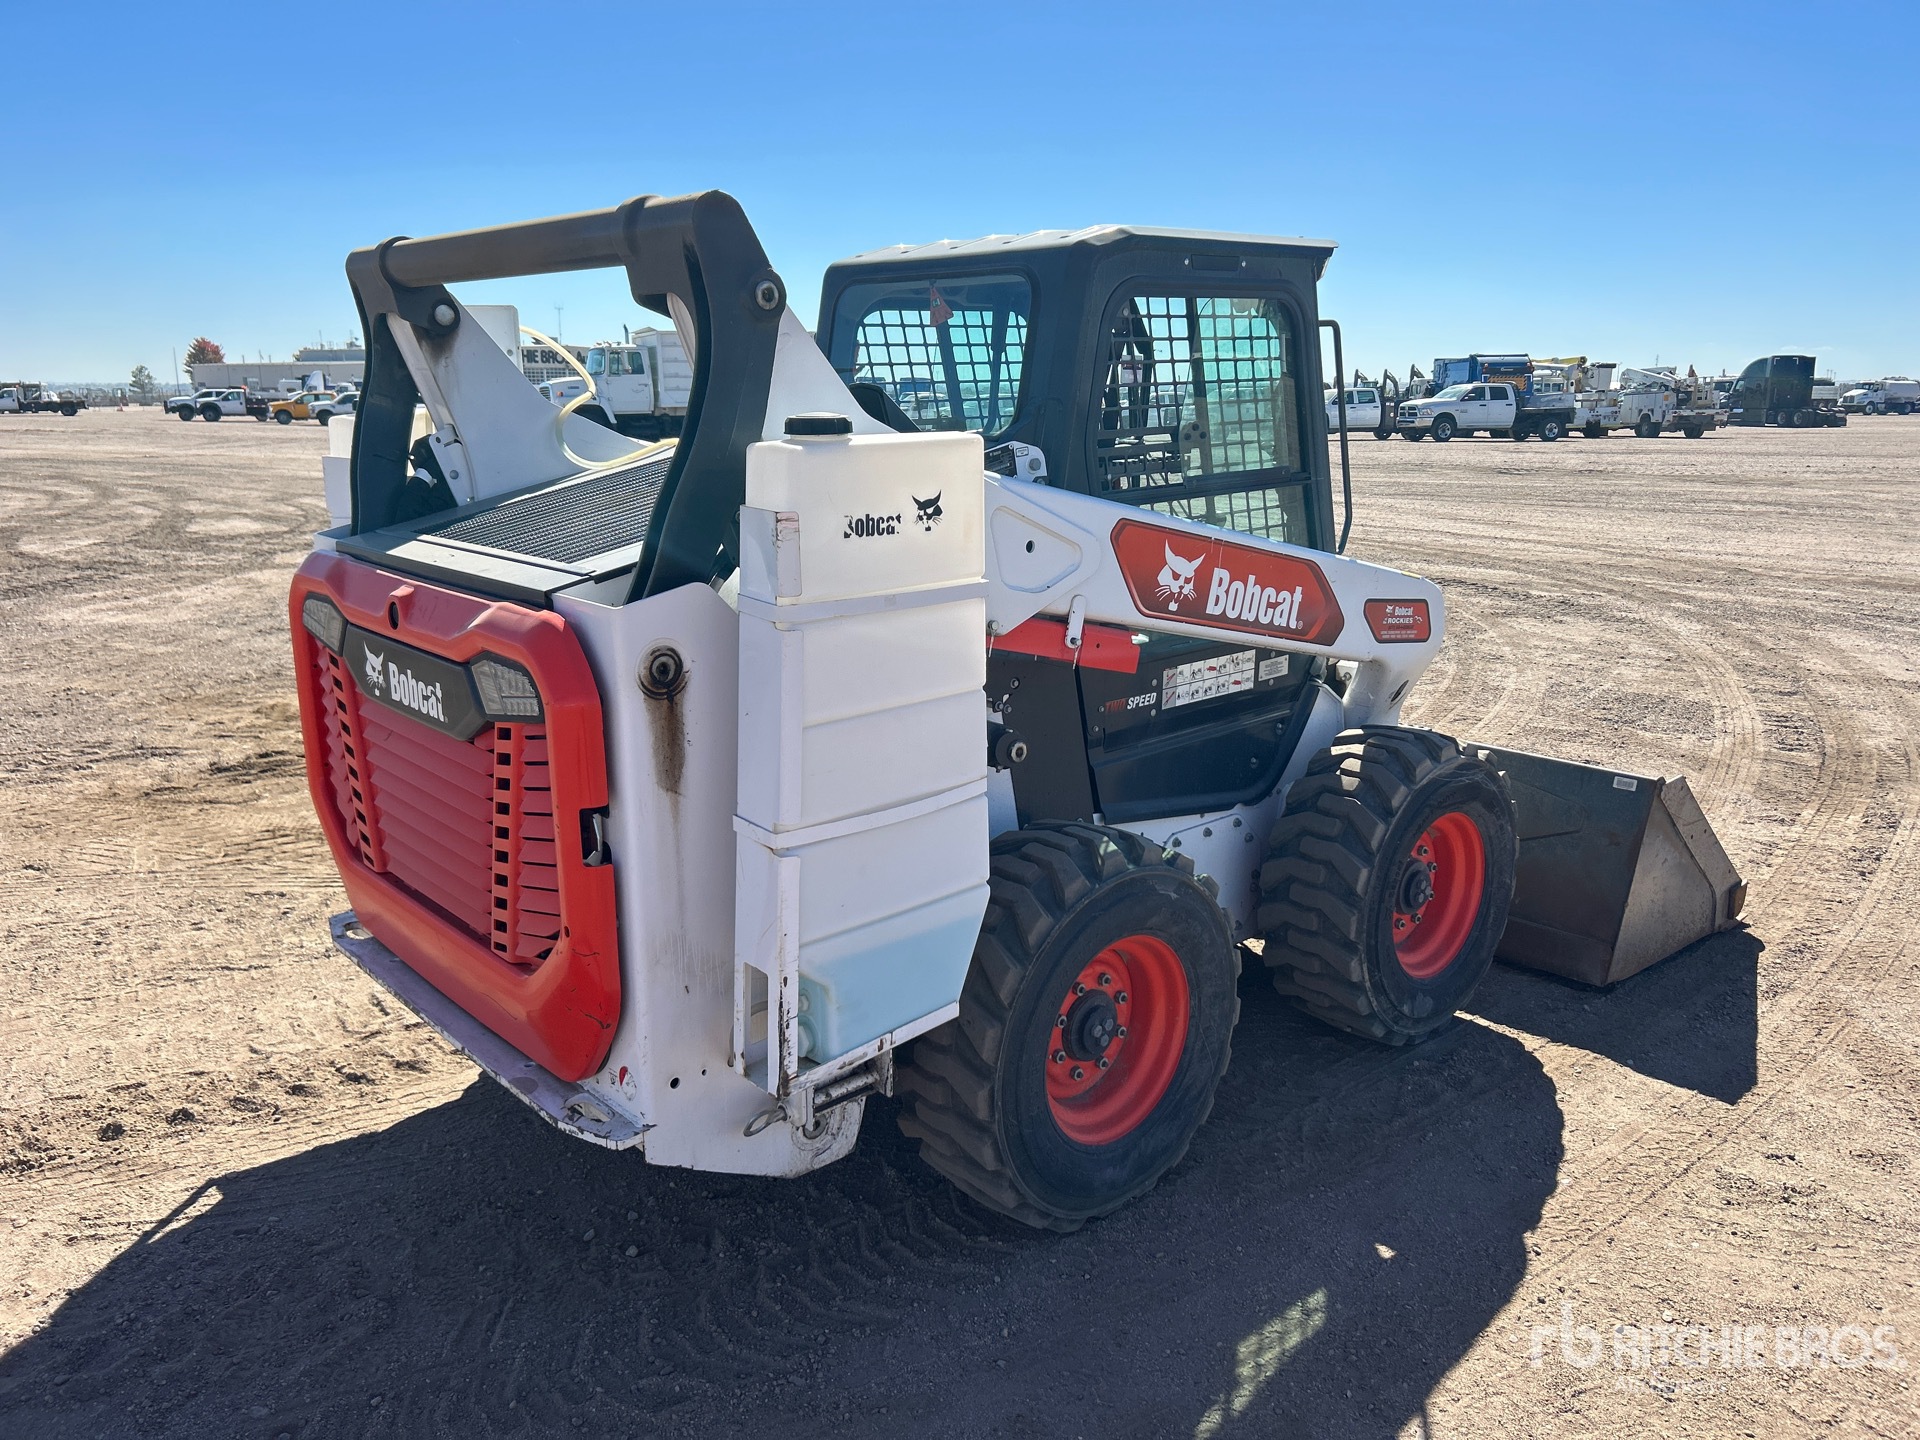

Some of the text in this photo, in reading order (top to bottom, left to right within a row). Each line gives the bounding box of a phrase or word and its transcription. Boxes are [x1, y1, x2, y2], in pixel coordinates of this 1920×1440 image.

[540, 350, 569, 364] BRO
[1206, 566, 1303, 629] Bobcat
[388, 662, 445, 723] Bobcat
[1126, 692, 1157, 710] SPEED
